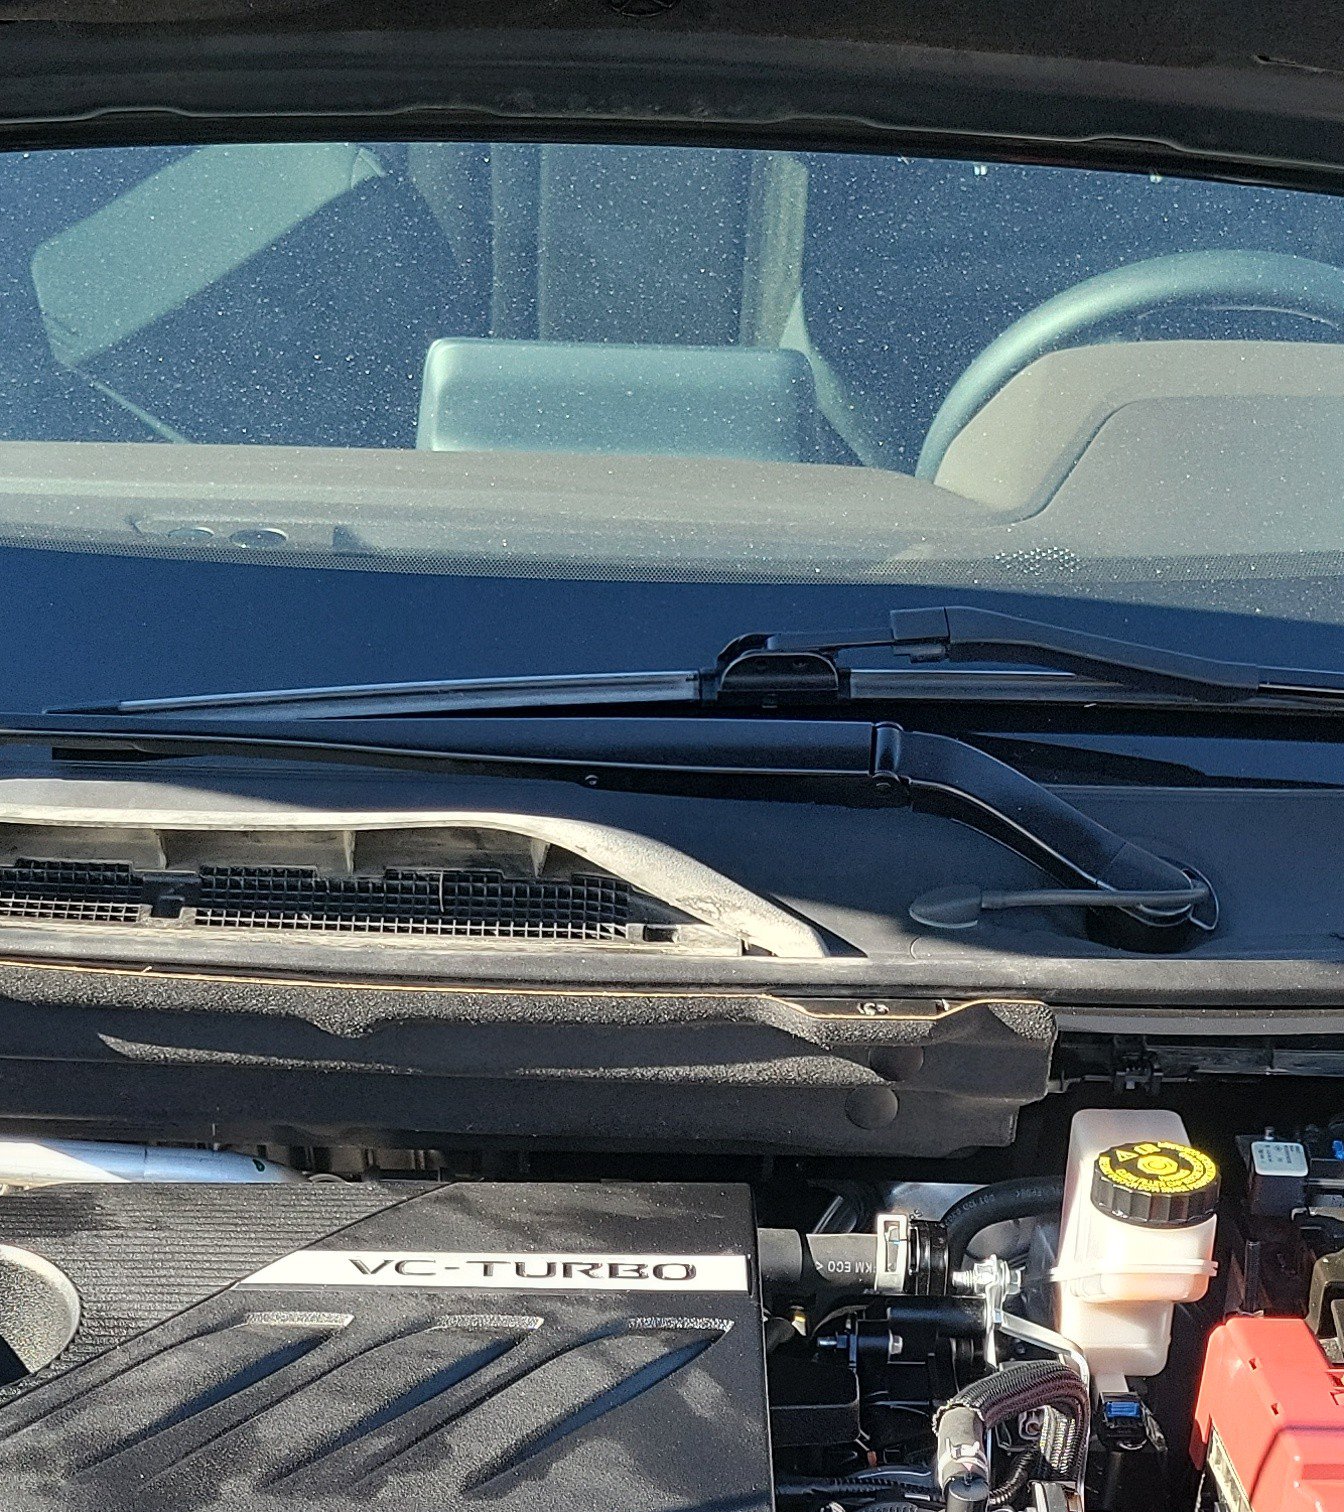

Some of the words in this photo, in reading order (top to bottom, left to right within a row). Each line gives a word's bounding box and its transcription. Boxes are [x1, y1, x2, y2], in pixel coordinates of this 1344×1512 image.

[348, 1258, 697, 1281] VC-TURBO
[828, 1261, 851, 1273] ECO
[856, 1262, 877, 1273] KM
